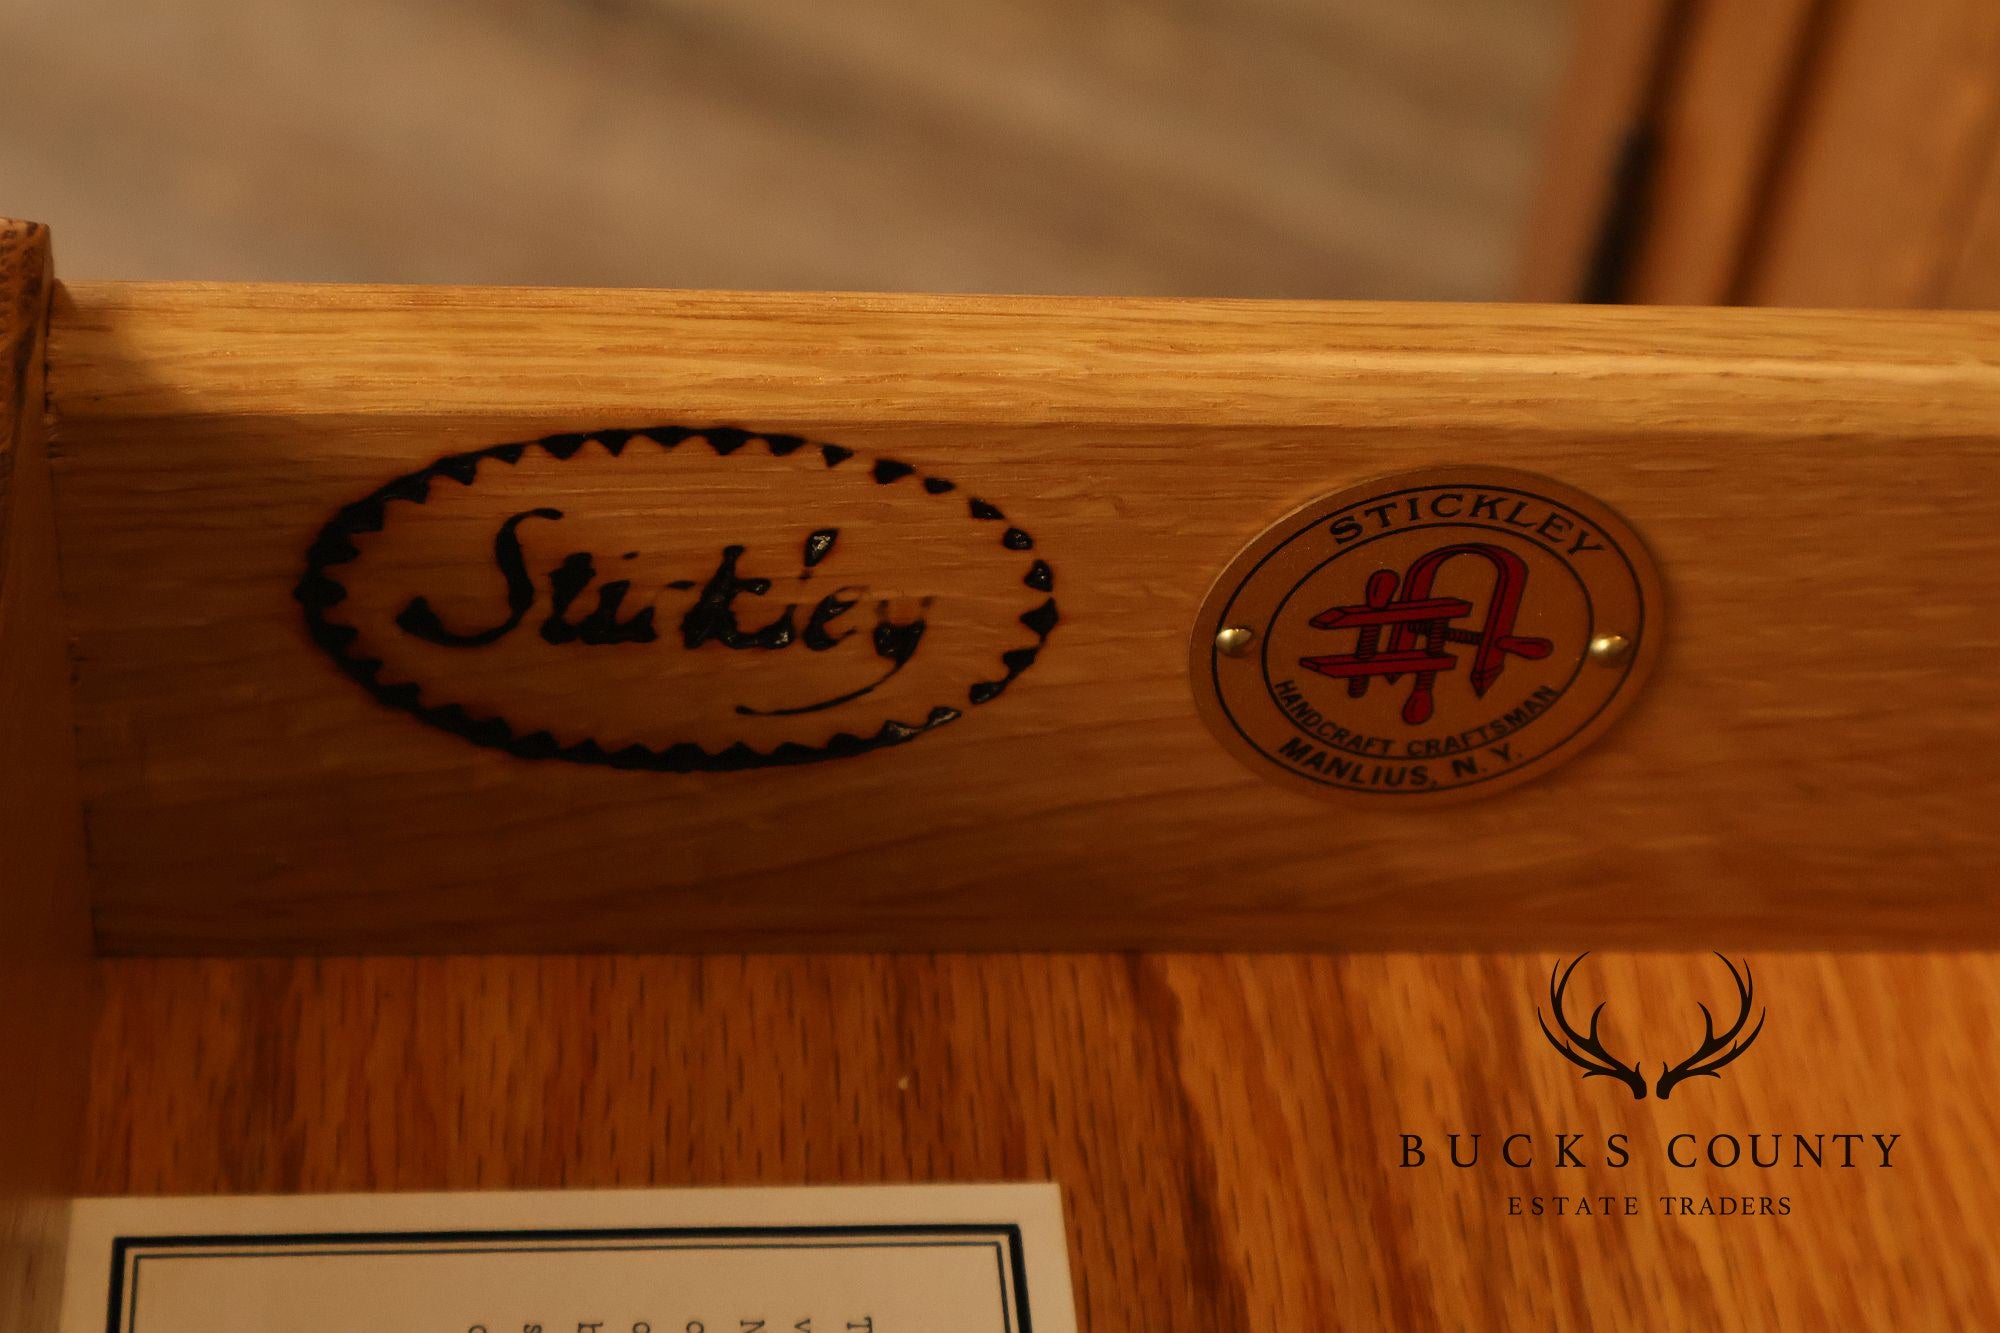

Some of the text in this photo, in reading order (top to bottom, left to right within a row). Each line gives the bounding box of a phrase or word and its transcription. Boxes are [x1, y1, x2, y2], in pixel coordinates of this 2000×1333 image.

[1330, 494, 1604, 556] STICKLEY
[1274, 679, 1560, 756] HANDCRAFT CRAFTSMAN
